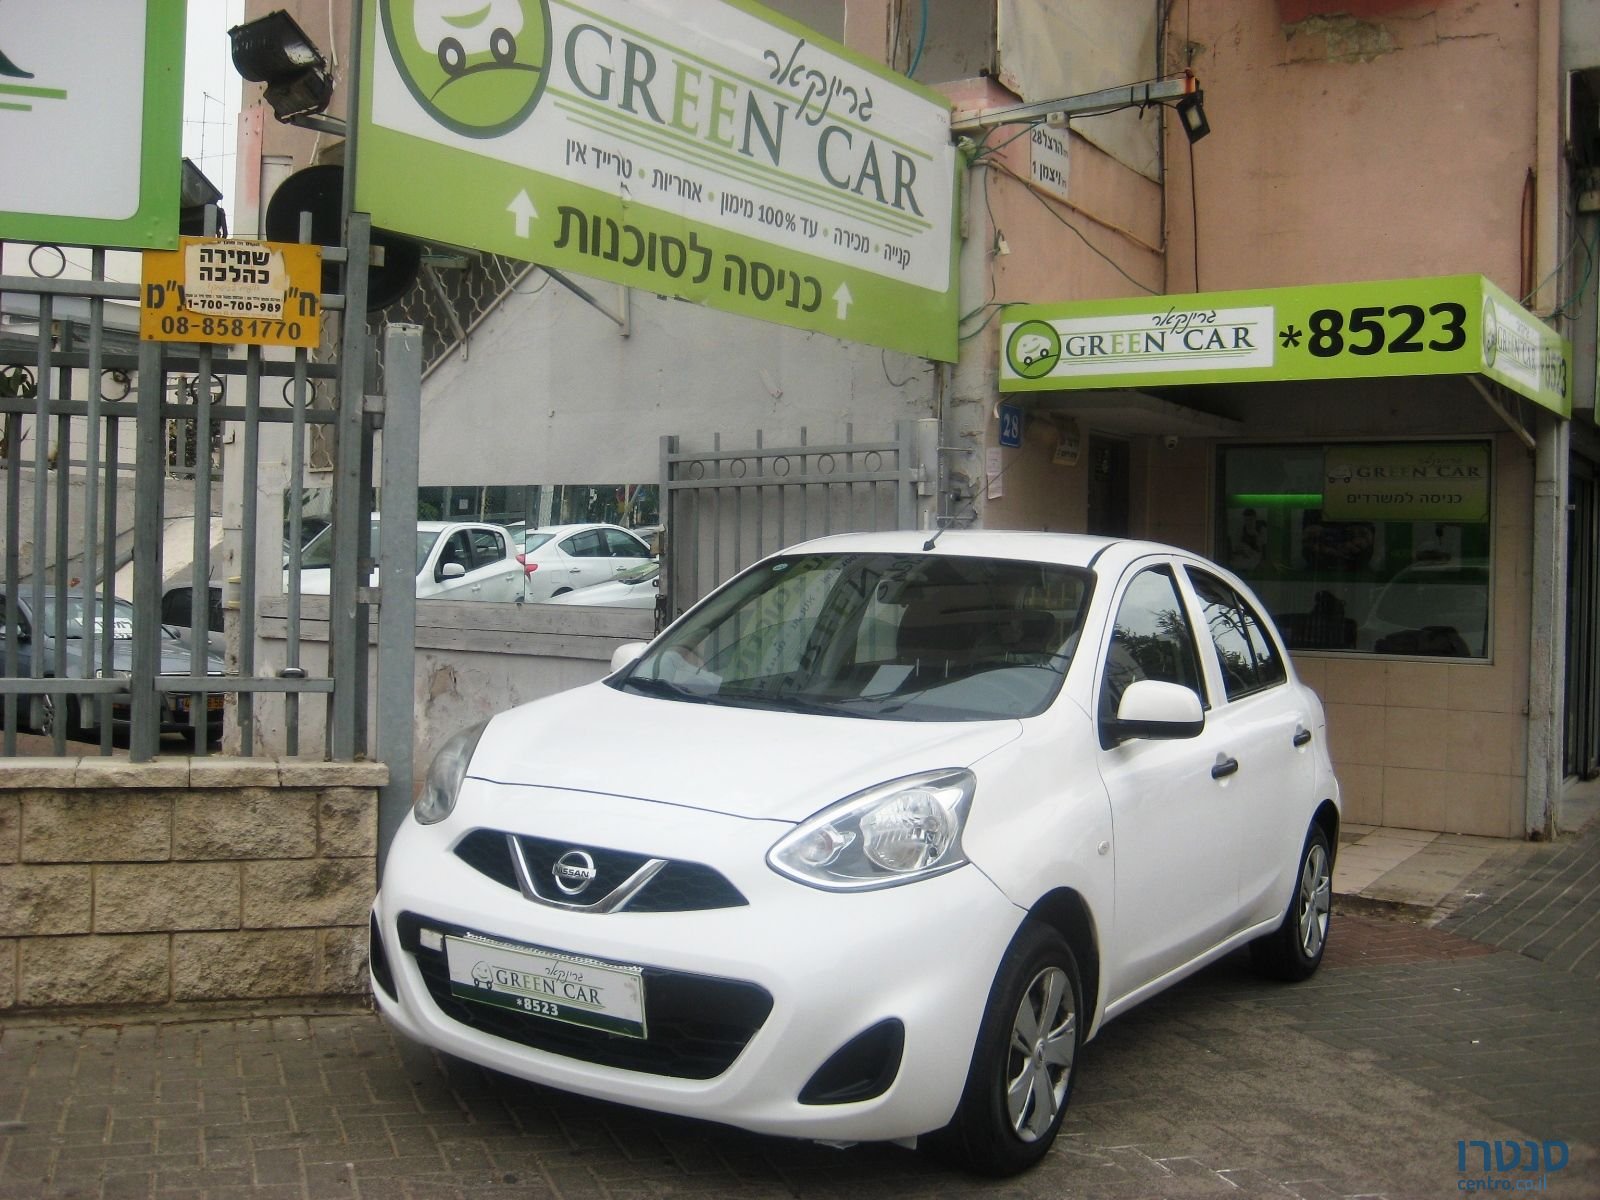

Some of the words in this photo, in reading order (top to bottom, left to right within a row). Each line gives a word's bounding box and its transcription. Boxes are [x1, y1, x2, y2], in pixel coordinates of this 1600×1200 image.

[764, 38, 873, 127] גרינקאר
[564, 23, 789, 167] GREEN
[817, 124, 924, 217] CAR
[565, 138, 588, 166] אין
[591, 146, 633, 179] טרייד
[651, 168, 703, 203] אחריות
[720, 191, 754, 219] מימון
[757, 204, 797, 232] 100%
[799, 216, 818, 239] עד
[833, 227, 870, 254] מכירה
[200, 248, 270, 266] שמירה
[553, 205, 713, 285] לסוכנות
[883, 243, 911, 270] קנייה
[199, 266, 270, 284] כהלכה
[723, 254, 823, 313] כניסה
[186, 299, 282, 313] 1-700-700-989
[161, 315, 301, 340] 08-8581770
[1151, 306, 1217, 335] גרינקאר
[1065, 330, 1167, 357] GREEN
[1182, 326, 1255, 351] CAR
[1003, 413, 1019, 439] 28
[1356, 466, 1427, 479] GREEN
[1437, 465, 1481, 478] CAR
[1346, 491, 1414, 505] למשרדים
[1419, 493, 1463, 504] כניסה
[555, 865, 590, 878] NISSAN
[544, 960, 584, 983] גרינקאר
[495, 969, 556, 995] GREEN
[563, 983, 603, 1005] CAR
